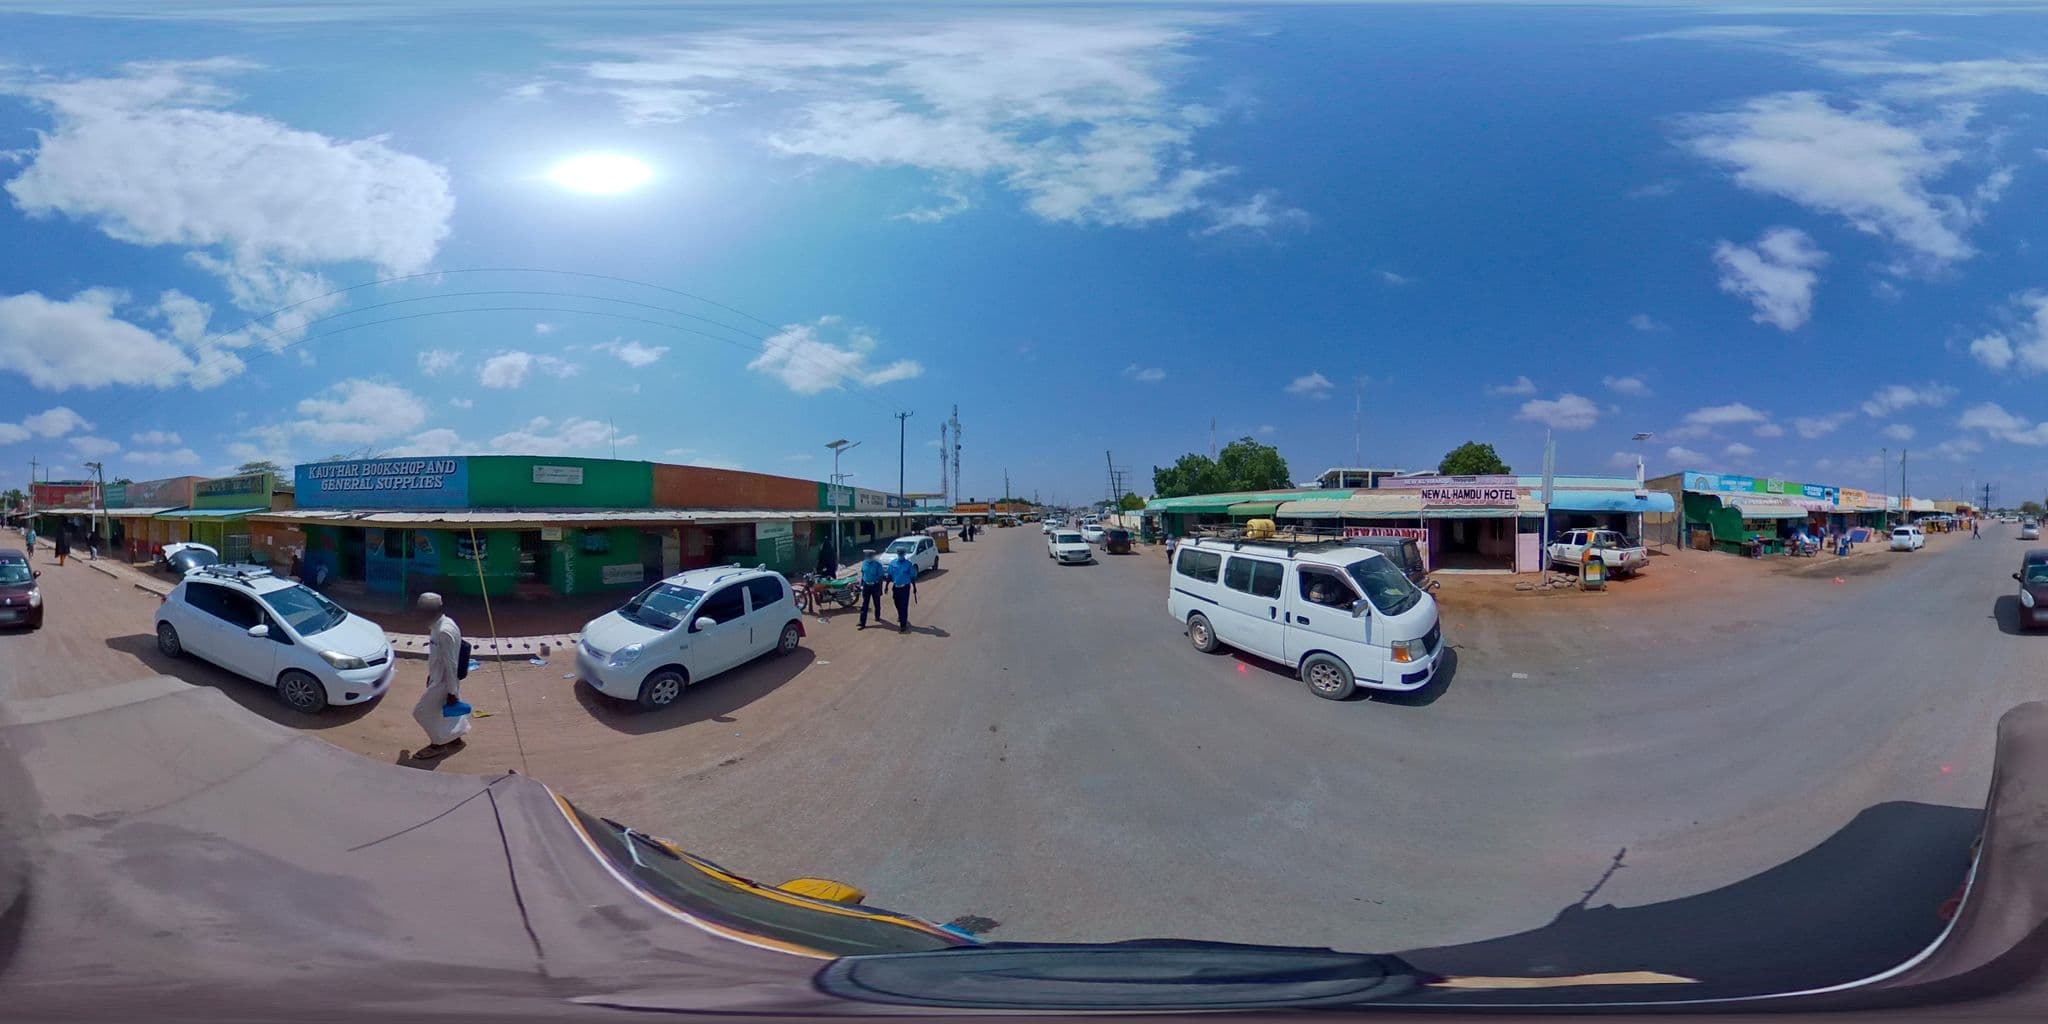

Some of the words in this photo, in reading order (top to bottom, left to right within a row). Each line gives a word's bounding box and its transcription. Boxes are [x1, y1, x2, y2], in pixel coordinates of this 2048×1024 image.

[309, 465, 359, 479] KAUTHAR
[362, 461, 425, 476] BOOKSHOP
[426, 460, 456, 474] AND
[321, 478, 374, 491] GENERAL
[376, 475, 443, 490] SUPPLIES
[1422, 489, 1440, 499] NEW
[1483, 489, 1516, 500] HOTEL
